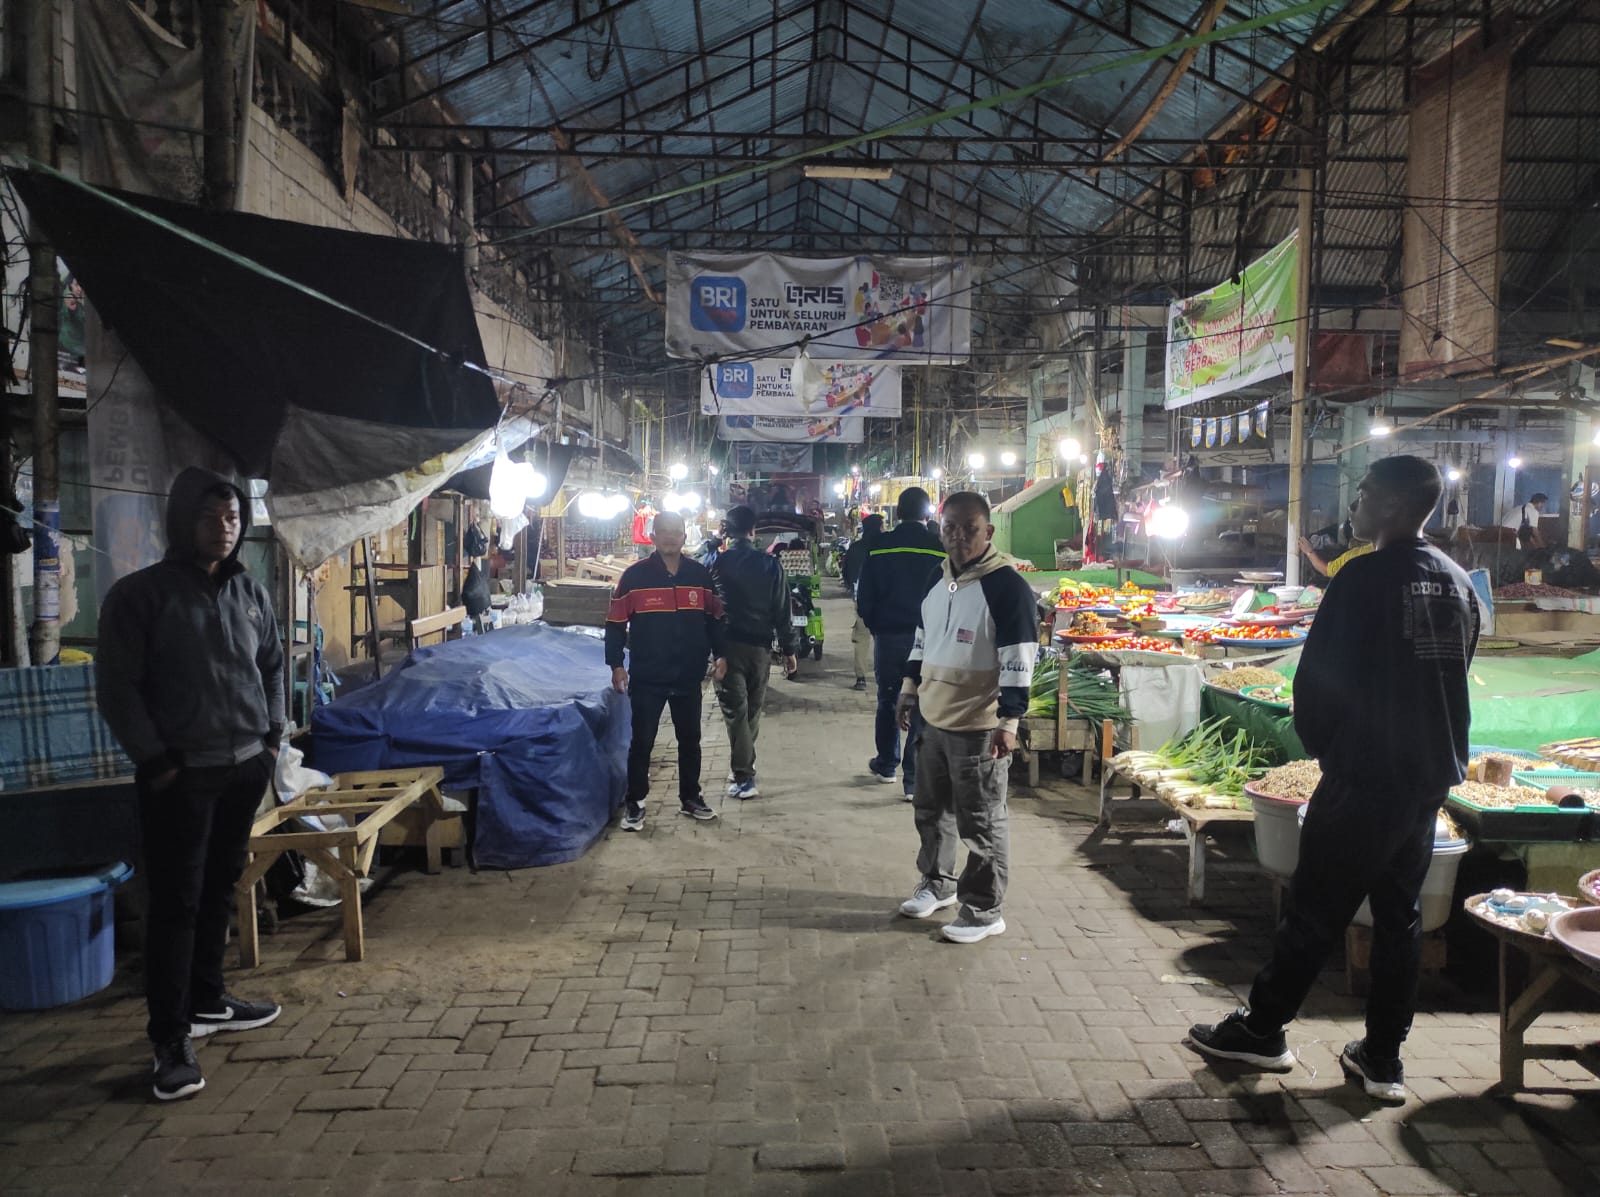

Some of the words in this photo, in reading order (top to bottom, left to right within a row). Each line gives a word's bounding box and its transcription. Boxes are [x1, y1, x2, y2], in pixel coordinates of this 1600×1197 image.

[700, 286, 737, 308] BRI
[785, 286, 844, 307] QRIS
[751, 298, 780, 307] SATU
[750, 309, 790, 319] UNTUK
[794, 310, 846, 321] SELURUH
[750, 320, 828, 331] PEMBAYARAN
[722, 368, 748, 383] BRI
[756, 375, 776, 383] SATU
[756, 383, 783, 391] UNTUK
